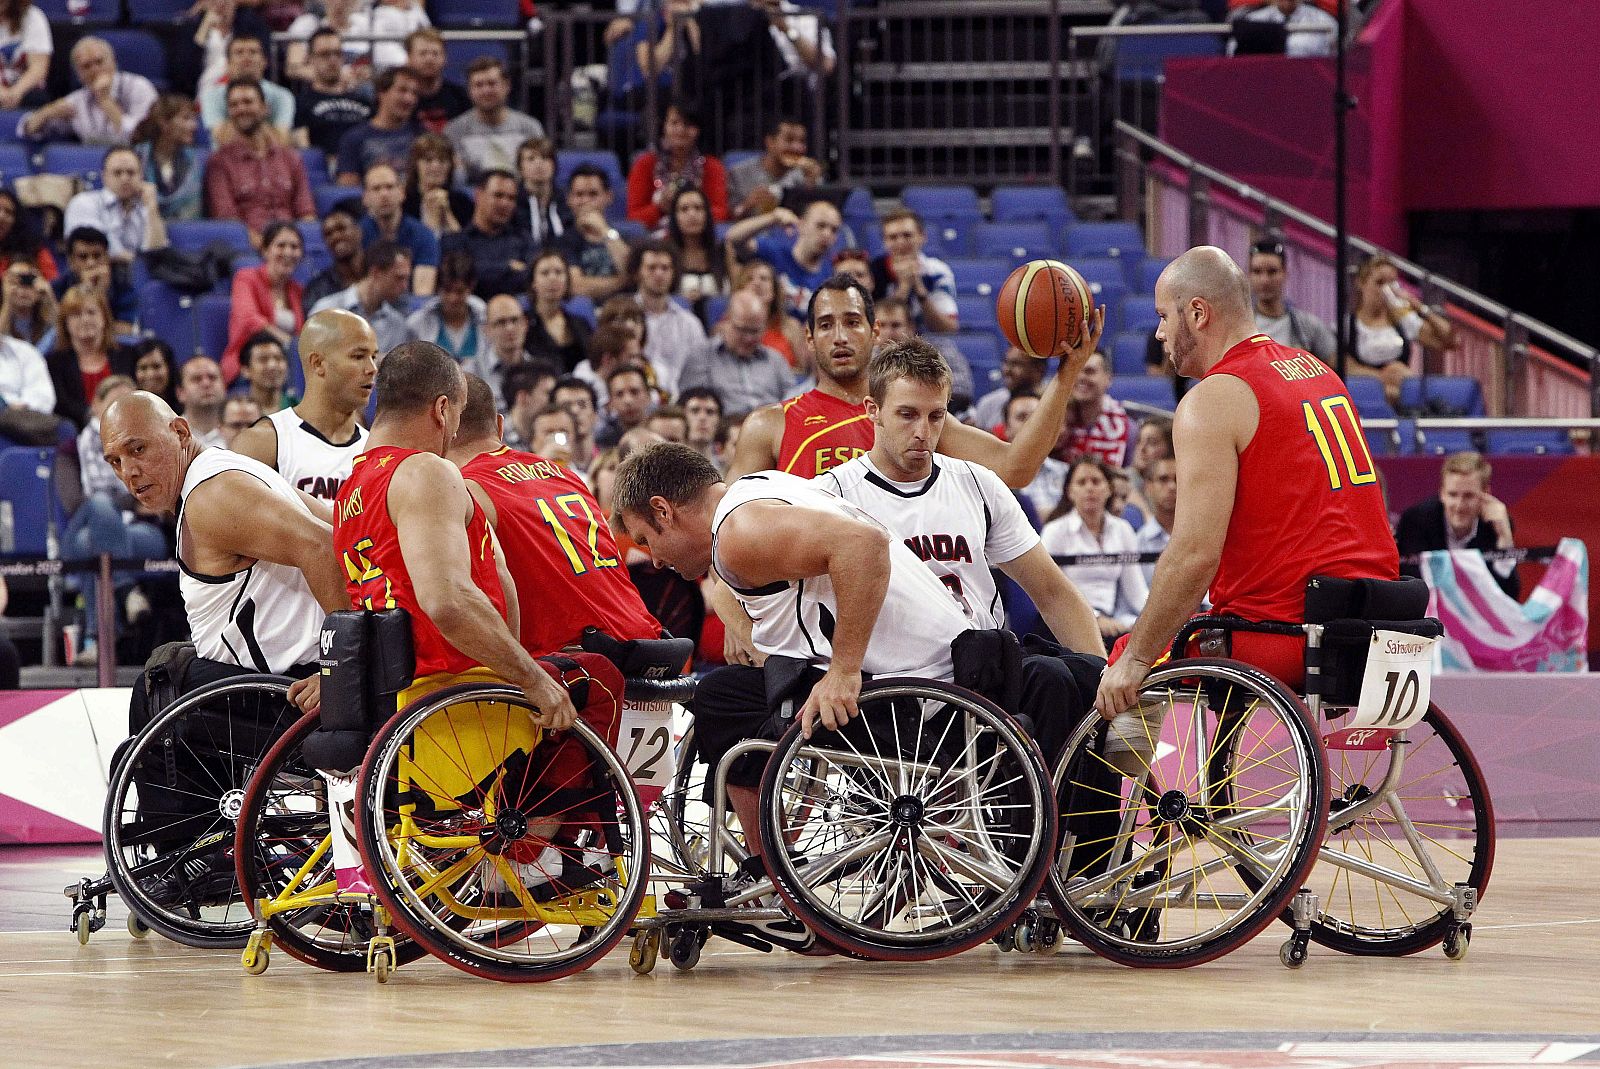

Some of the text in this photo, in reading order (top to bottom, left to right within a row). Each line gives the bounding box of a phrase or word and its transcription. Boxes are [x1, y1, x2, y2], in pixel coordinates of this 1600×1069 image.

[1270, 353, 1328, 381] GARCÍA
[1301, 394, 1377, 491] 10
[815, 446, 866, 475] ESP
[297, 476, 347, 501] CAN
[535, 492, 619, 575] 12
[903, 534, 973, 563] NADA
[1370, 669, 1420, 726] 10
[1346, 729, 1378, 746] ESP
[625, 726, 670, 780] 12
[448, 951, 480, 968] KENDA
